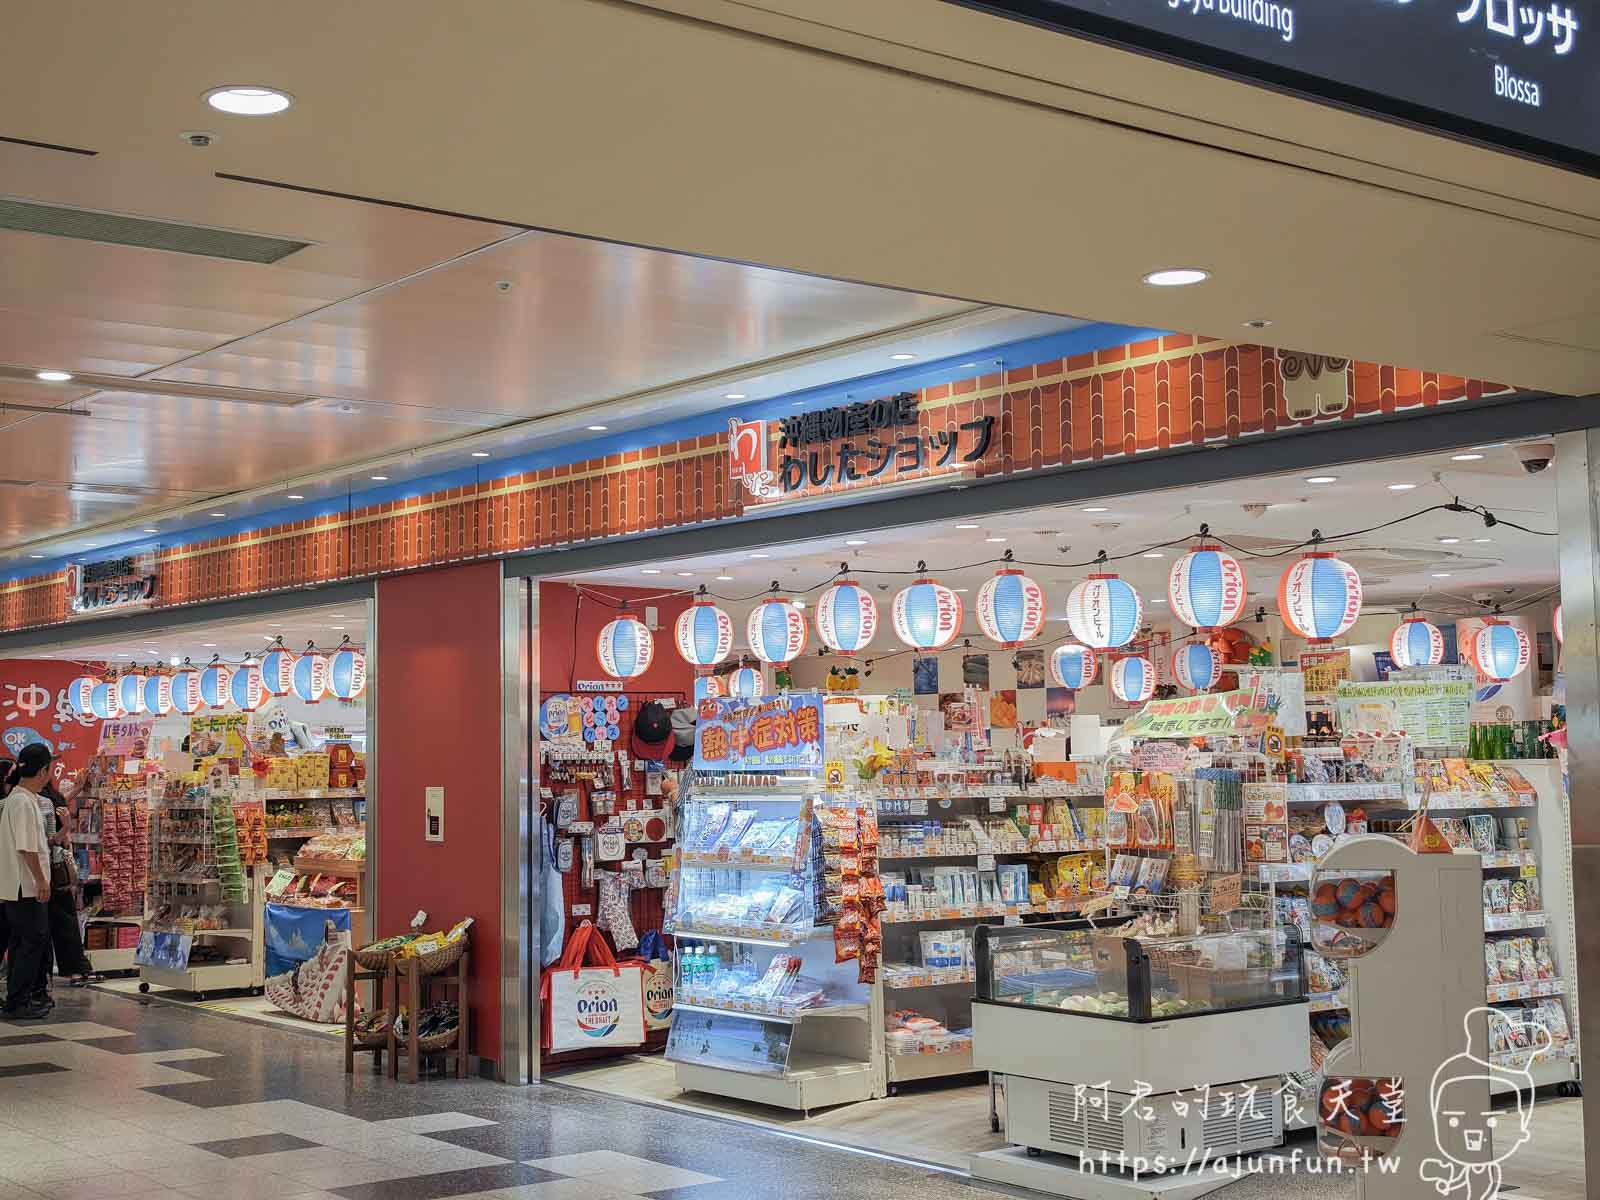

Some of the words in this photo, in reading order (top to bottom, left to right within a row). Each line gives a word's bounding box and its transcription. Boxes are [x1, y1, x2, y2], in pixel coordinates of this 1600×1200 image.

[1494, 64, 1540, 107] Blossa
[779, 391, 918, 449] 沖縄物産の店
[780, 415, 996, 492] わしたショップ
[701, 706, 819, 761] 熱中症対策
[577, 995, 618, 1014] Orion
[646, 986, 674, 1001] Orion
